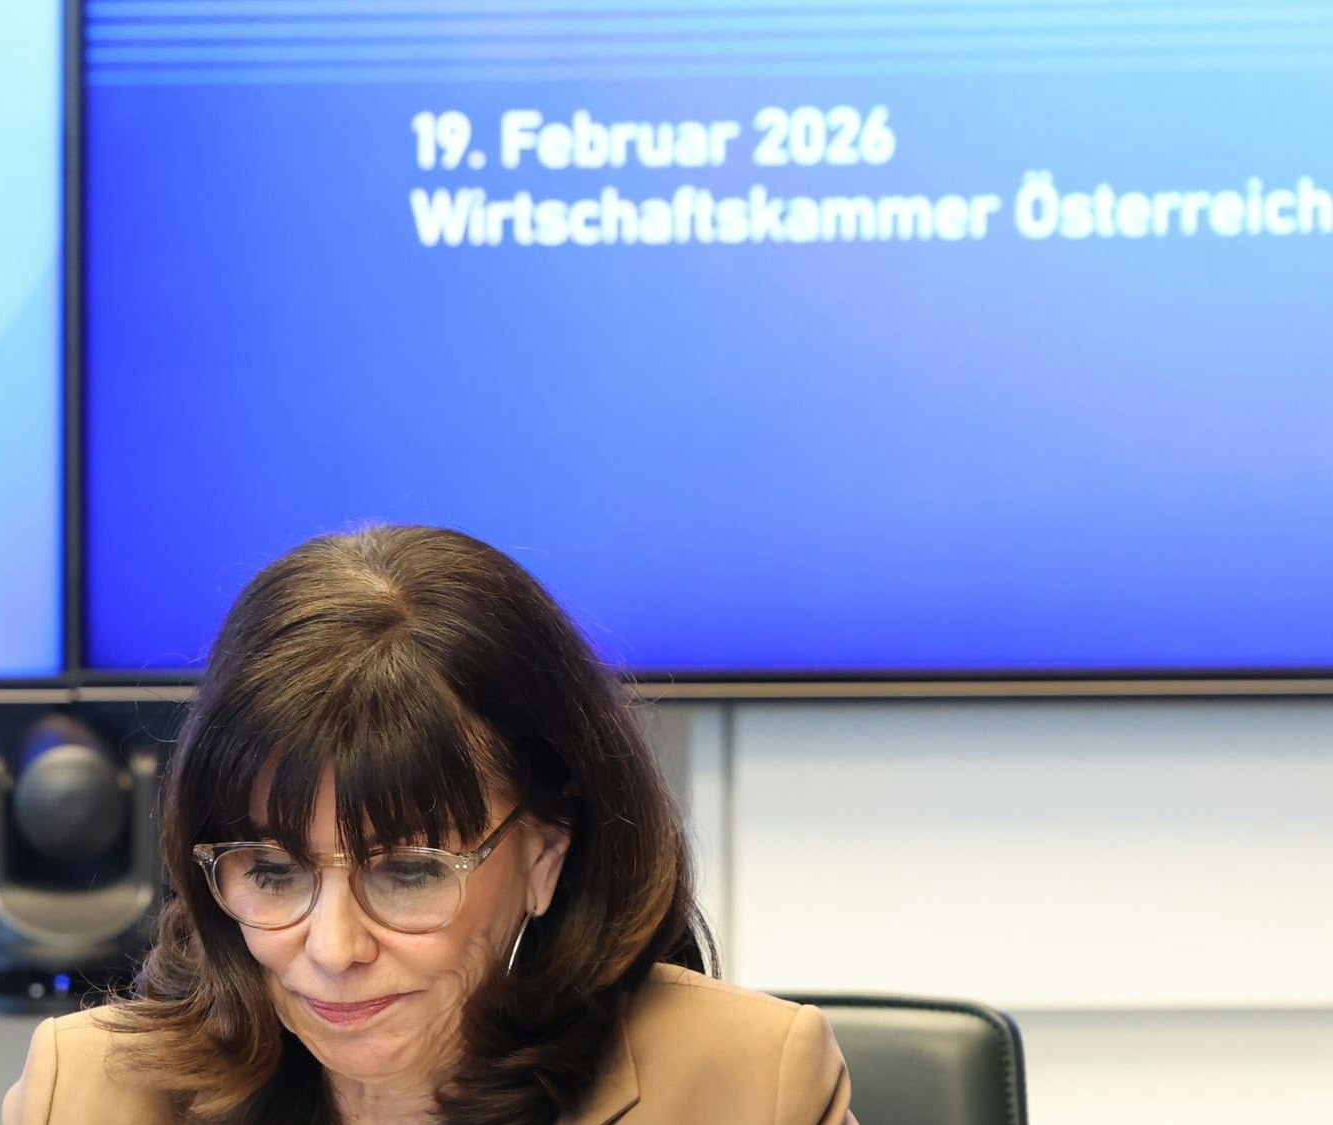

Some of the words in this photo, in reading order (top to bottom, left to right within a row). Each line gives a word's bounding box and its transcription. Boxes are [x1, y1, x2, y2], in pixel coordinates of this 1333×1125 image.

[411, 109, 486, 171] 19.
[501, 108, 740, 169] Februar
[754, 106, 896, 165] 2026
[409, 185, 1001, 247] Wirtschaftskammer
[1014, 170, 1332, 239] Österreich
